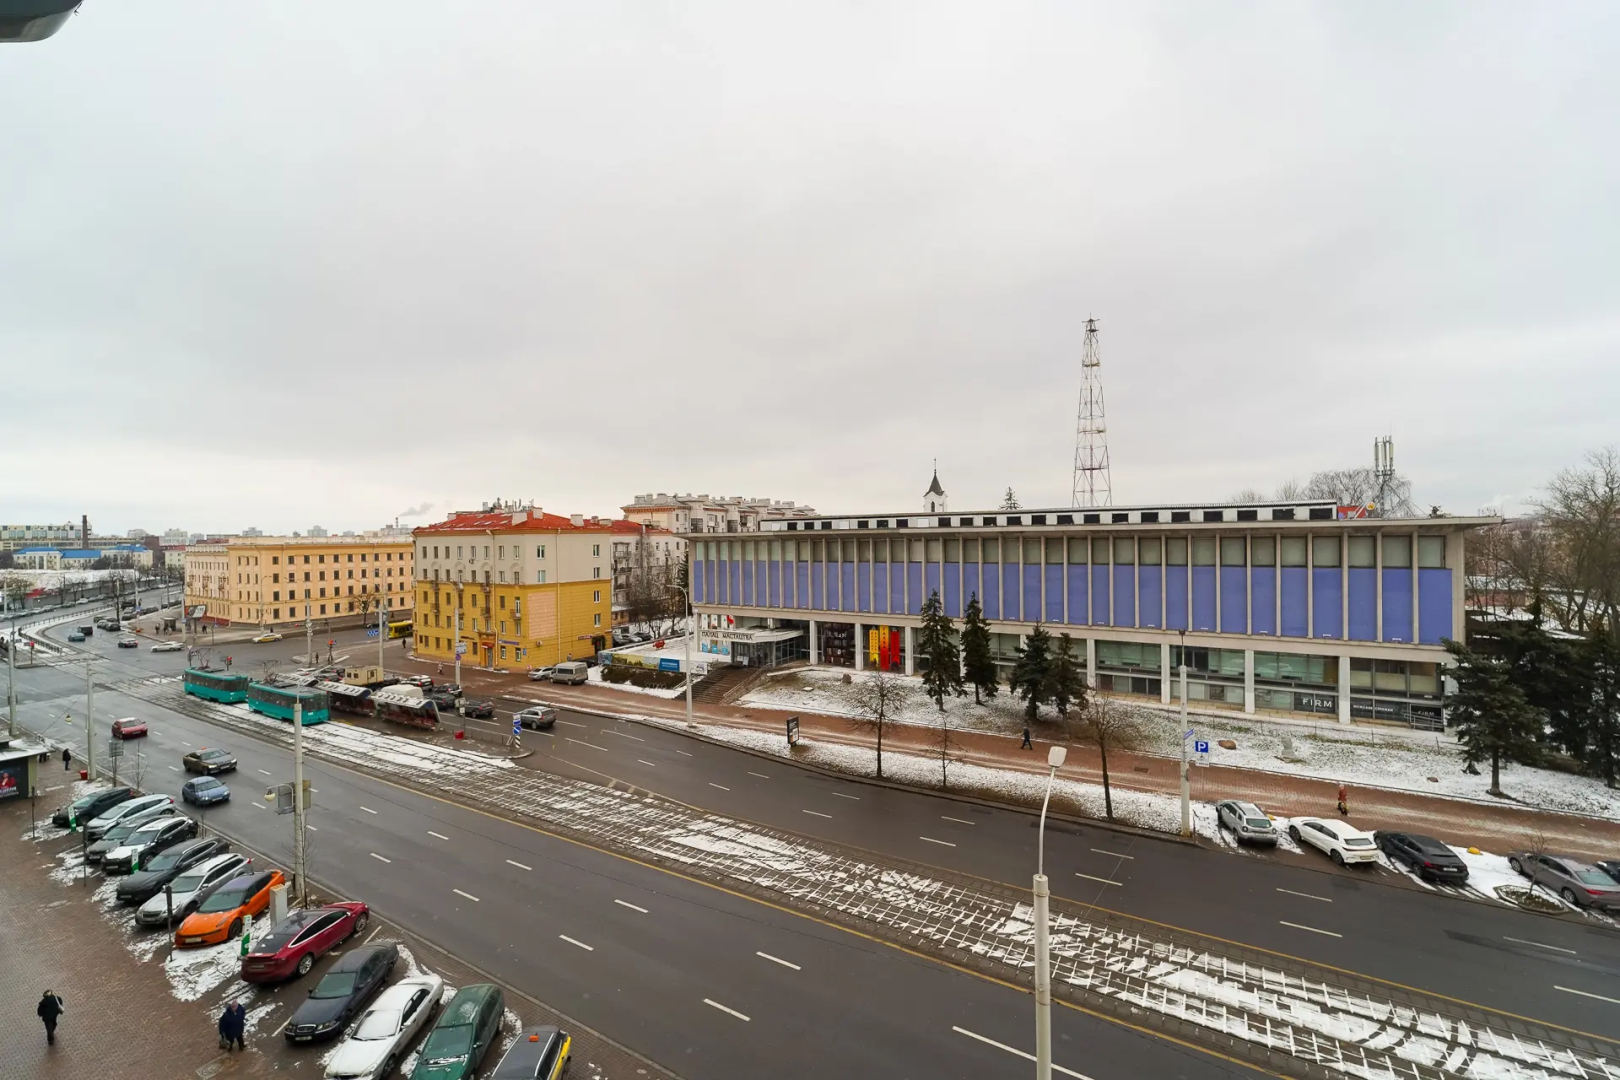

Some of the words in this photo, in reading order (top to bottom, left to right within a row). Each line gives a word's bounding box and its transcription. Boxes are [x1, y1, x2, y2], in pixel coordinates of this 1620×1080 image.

[701, 631, 719, 639] ПАЛАЦ
[722, 633, 753, 641] МАСТАЦТВА
[1302, 698, 1332, 708] FIRM
[1198, 741, 1206, 752] P
